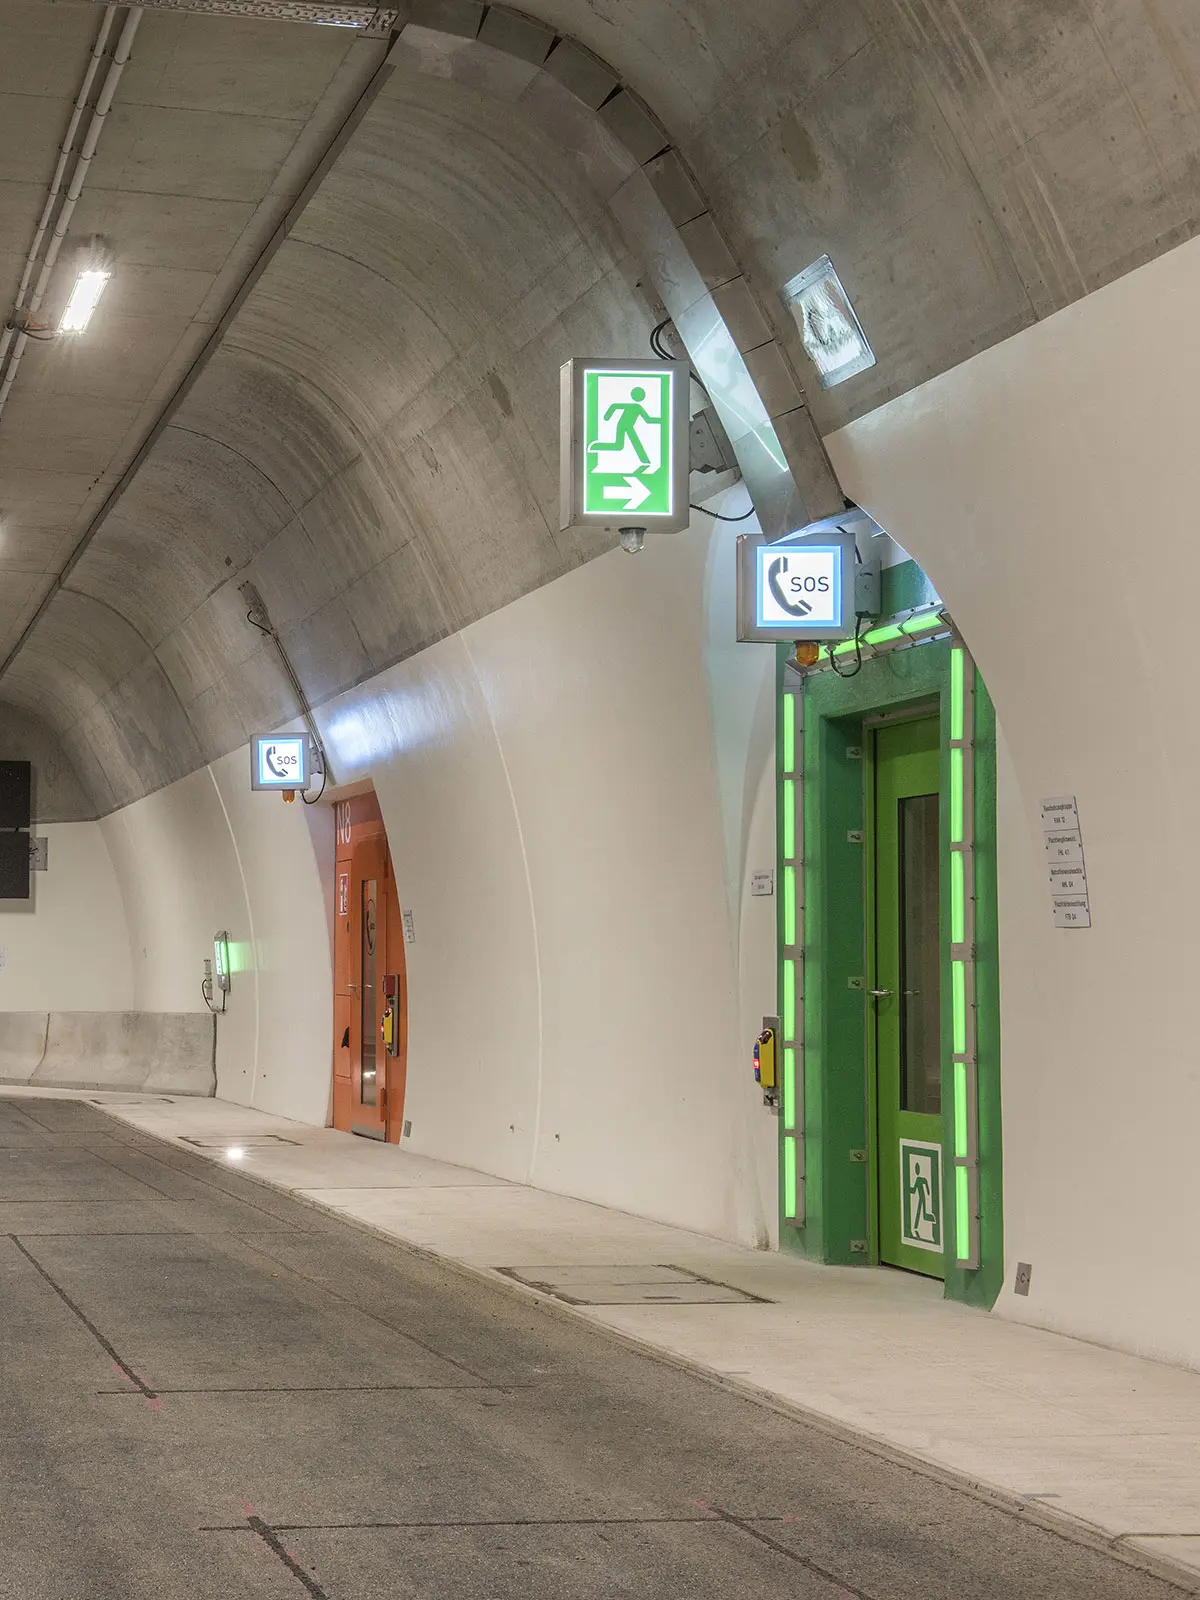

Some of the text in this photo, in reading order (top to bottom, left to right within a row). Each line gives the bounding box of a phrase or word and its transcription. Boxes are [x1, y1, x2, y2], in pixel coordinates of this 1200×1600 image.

[790, 576, 829, 592] SOS
[277, 756, 297, 765] SOS
[336, 801, 352, 845] N8
